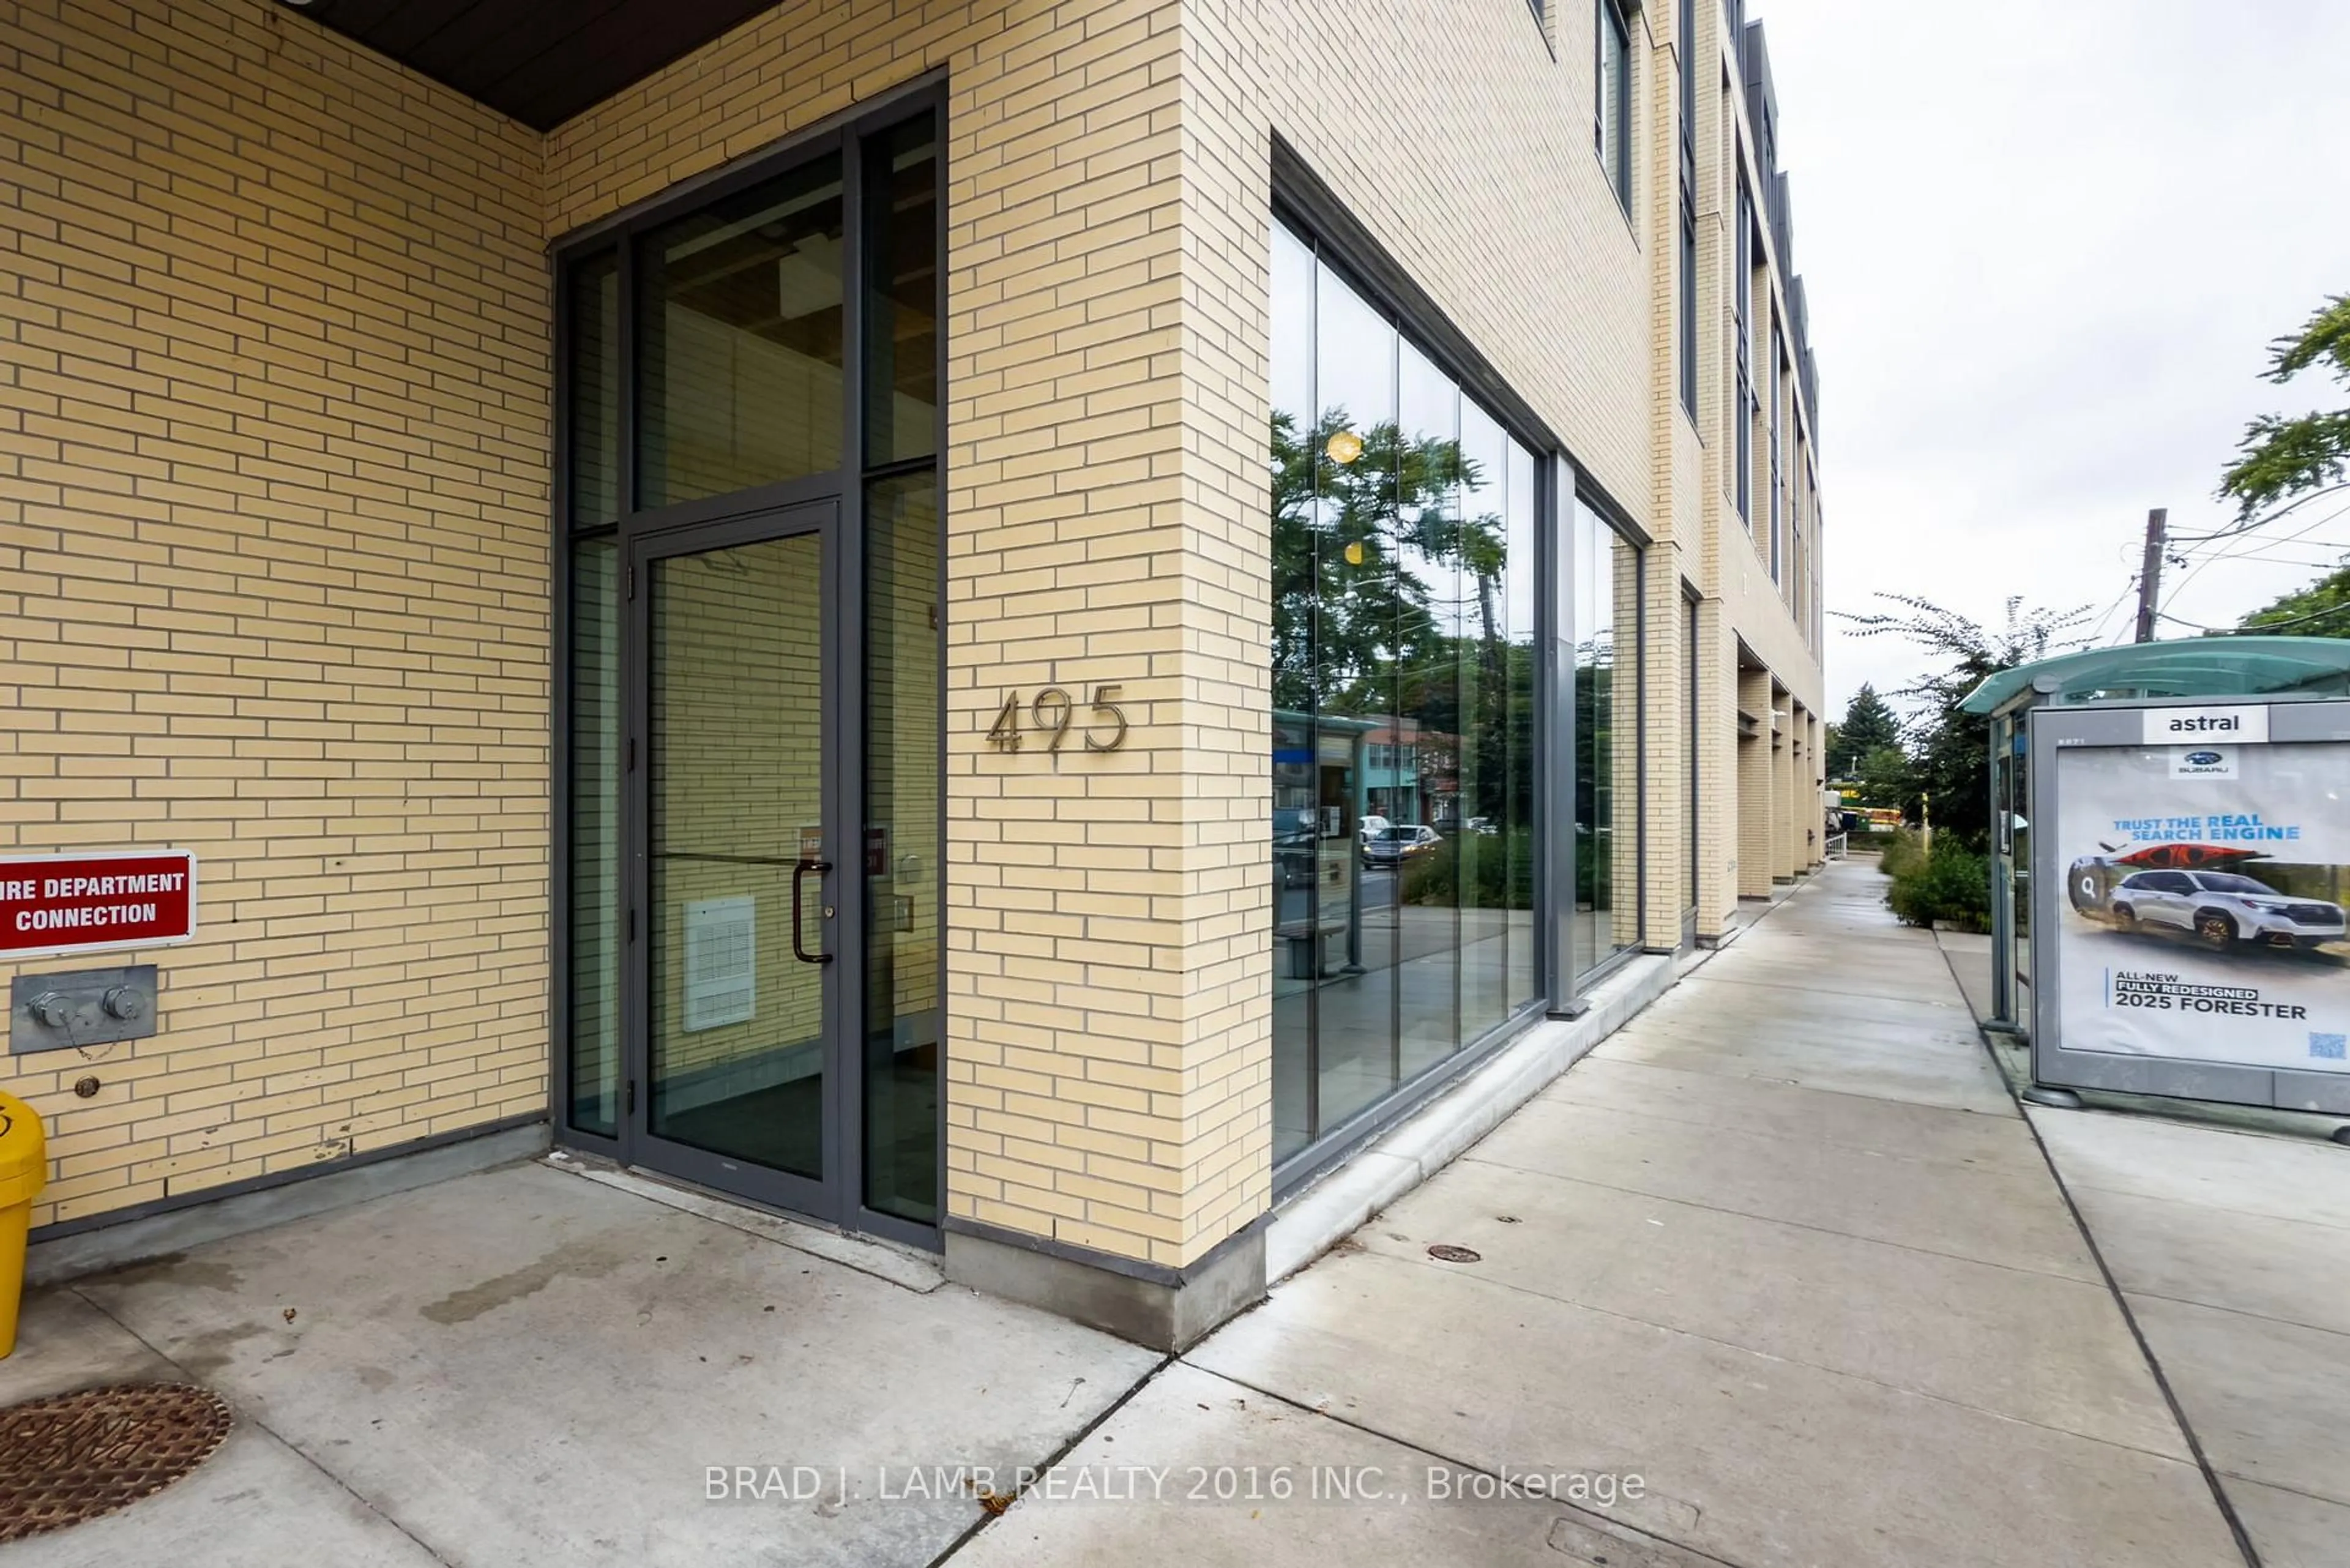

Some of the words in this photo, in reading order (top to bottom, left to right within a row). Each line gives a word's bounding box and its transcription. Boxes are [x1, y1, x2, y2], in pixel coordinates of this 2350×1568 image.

[986, 685, 1127, 753] 495
[2169, 715, 2239, 731] astral
[2114, 819, 2163, 831] TRUST
[2166, 816, 2201, 829] THE
[2207, 814, 2262, 827] REAL
[2132, 829, 2202, 840] SEARCH
[2210, 826, 2301, 840] ENGINE
[0, 880, 35, 900] IRE
[45, 873, 184, 898] DEPARTMENT
[16, 903, 156, 931] CONNECTION
[2117, 971, 2178, 982] ALL-NEW
[2118, 981, 2158, 992] FULLY
[2162, 985, 2256, 999] REDESIGNED
[2116, 993, 2171, 1009] 2025
[2180, 998, 2307, 1020] FORESTER
[0, 1439, 143, 1468] DANGE
